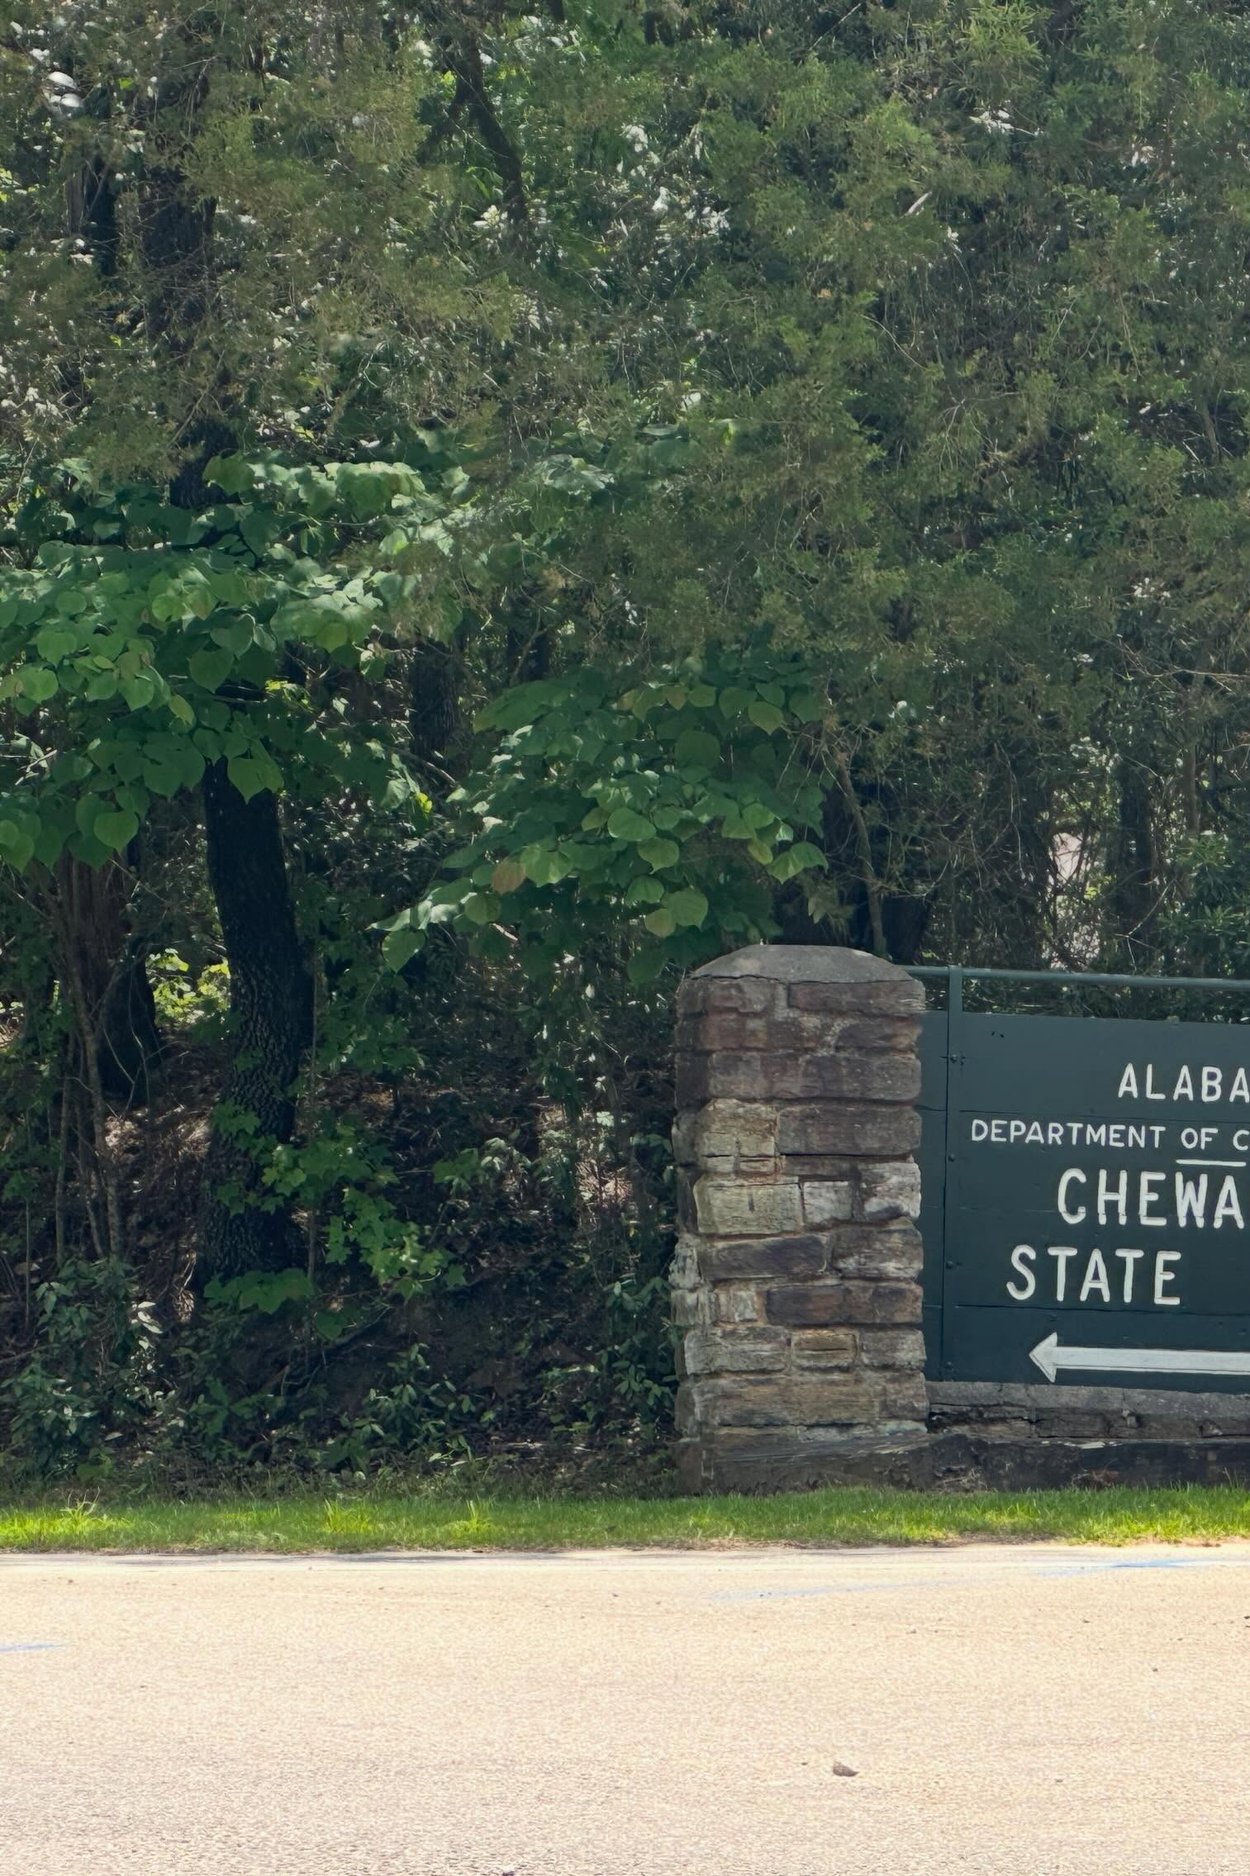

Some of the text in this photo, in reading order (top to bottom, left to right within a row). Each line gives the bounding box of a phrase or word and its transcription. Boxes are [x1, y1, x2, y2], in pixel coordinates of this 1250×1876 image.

[971, 1119, 1166, 1149] DEPARTMENT
[1180, 1127, 1219, 1150] OF
[1006, 1244, 1182, 1306] STATE
